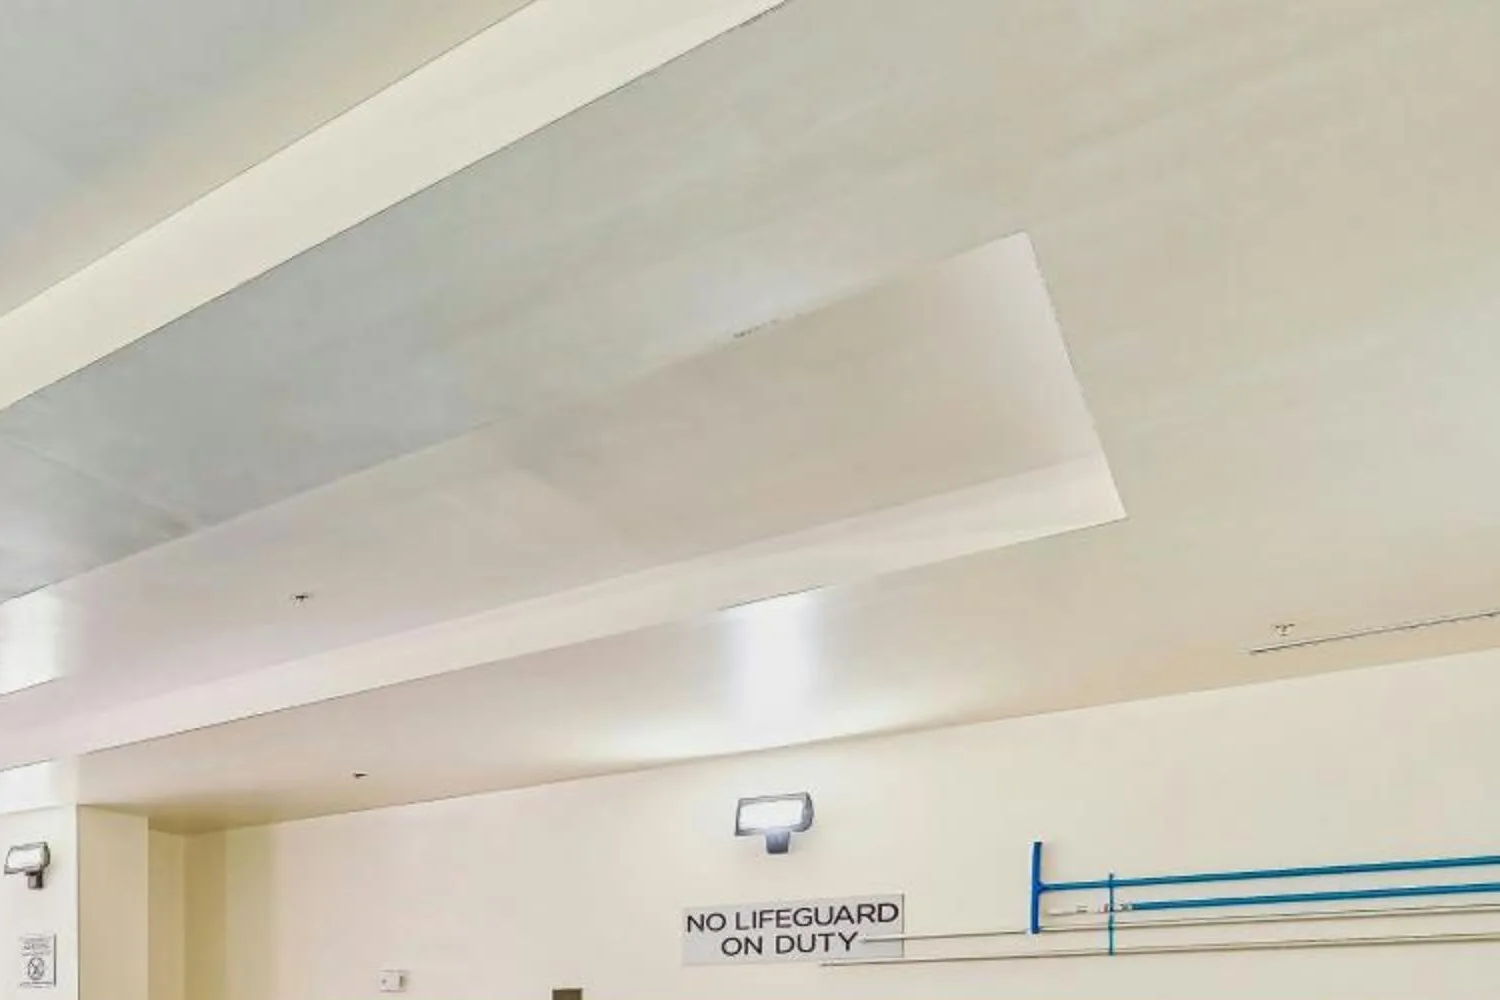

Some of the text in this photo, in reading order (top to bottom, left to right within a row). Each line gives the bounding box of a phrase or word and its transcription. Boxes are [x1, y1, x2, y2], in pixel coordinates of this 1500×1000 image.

[687, 903, 899, 932] NO LIFEGUARD
[721, 931, 858, 956] ON DUTY
